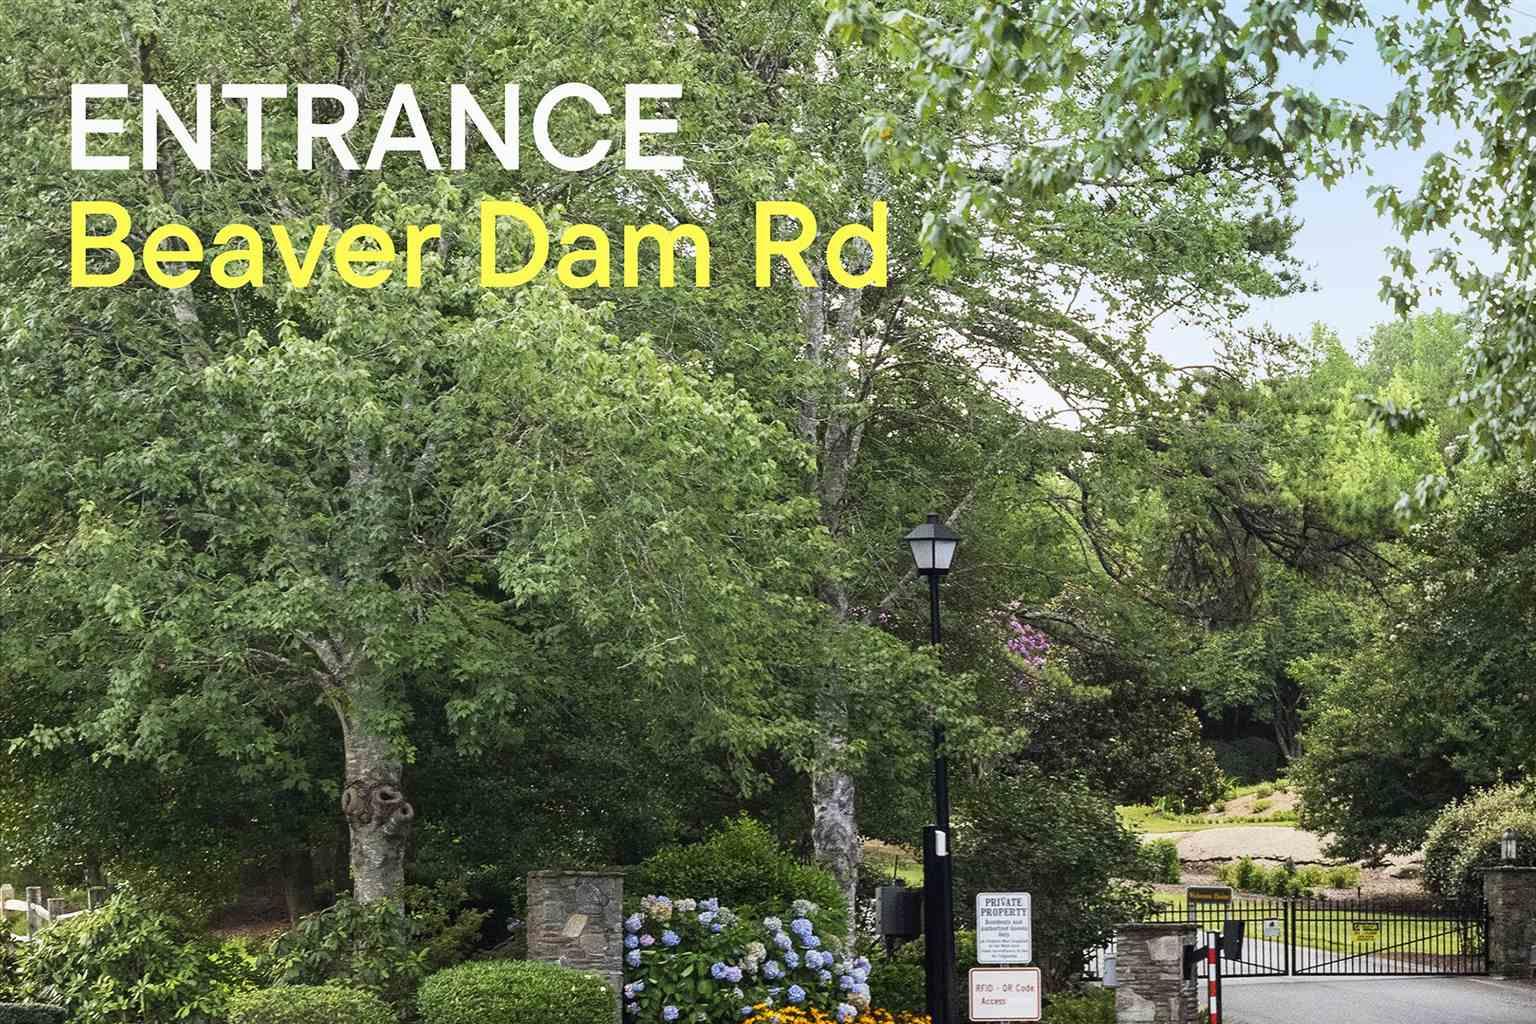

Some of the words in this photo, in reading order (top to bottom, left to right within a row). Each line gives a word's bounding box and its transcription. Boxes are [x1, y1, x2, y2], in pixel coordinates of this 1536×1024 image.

[985, 897, 1024, 907] PRIVATE
[981, 908, 1027, 917] PROPERTY
[1015, 983, 1035, 993] Code
[981, 997, 1007, 1005] Access
